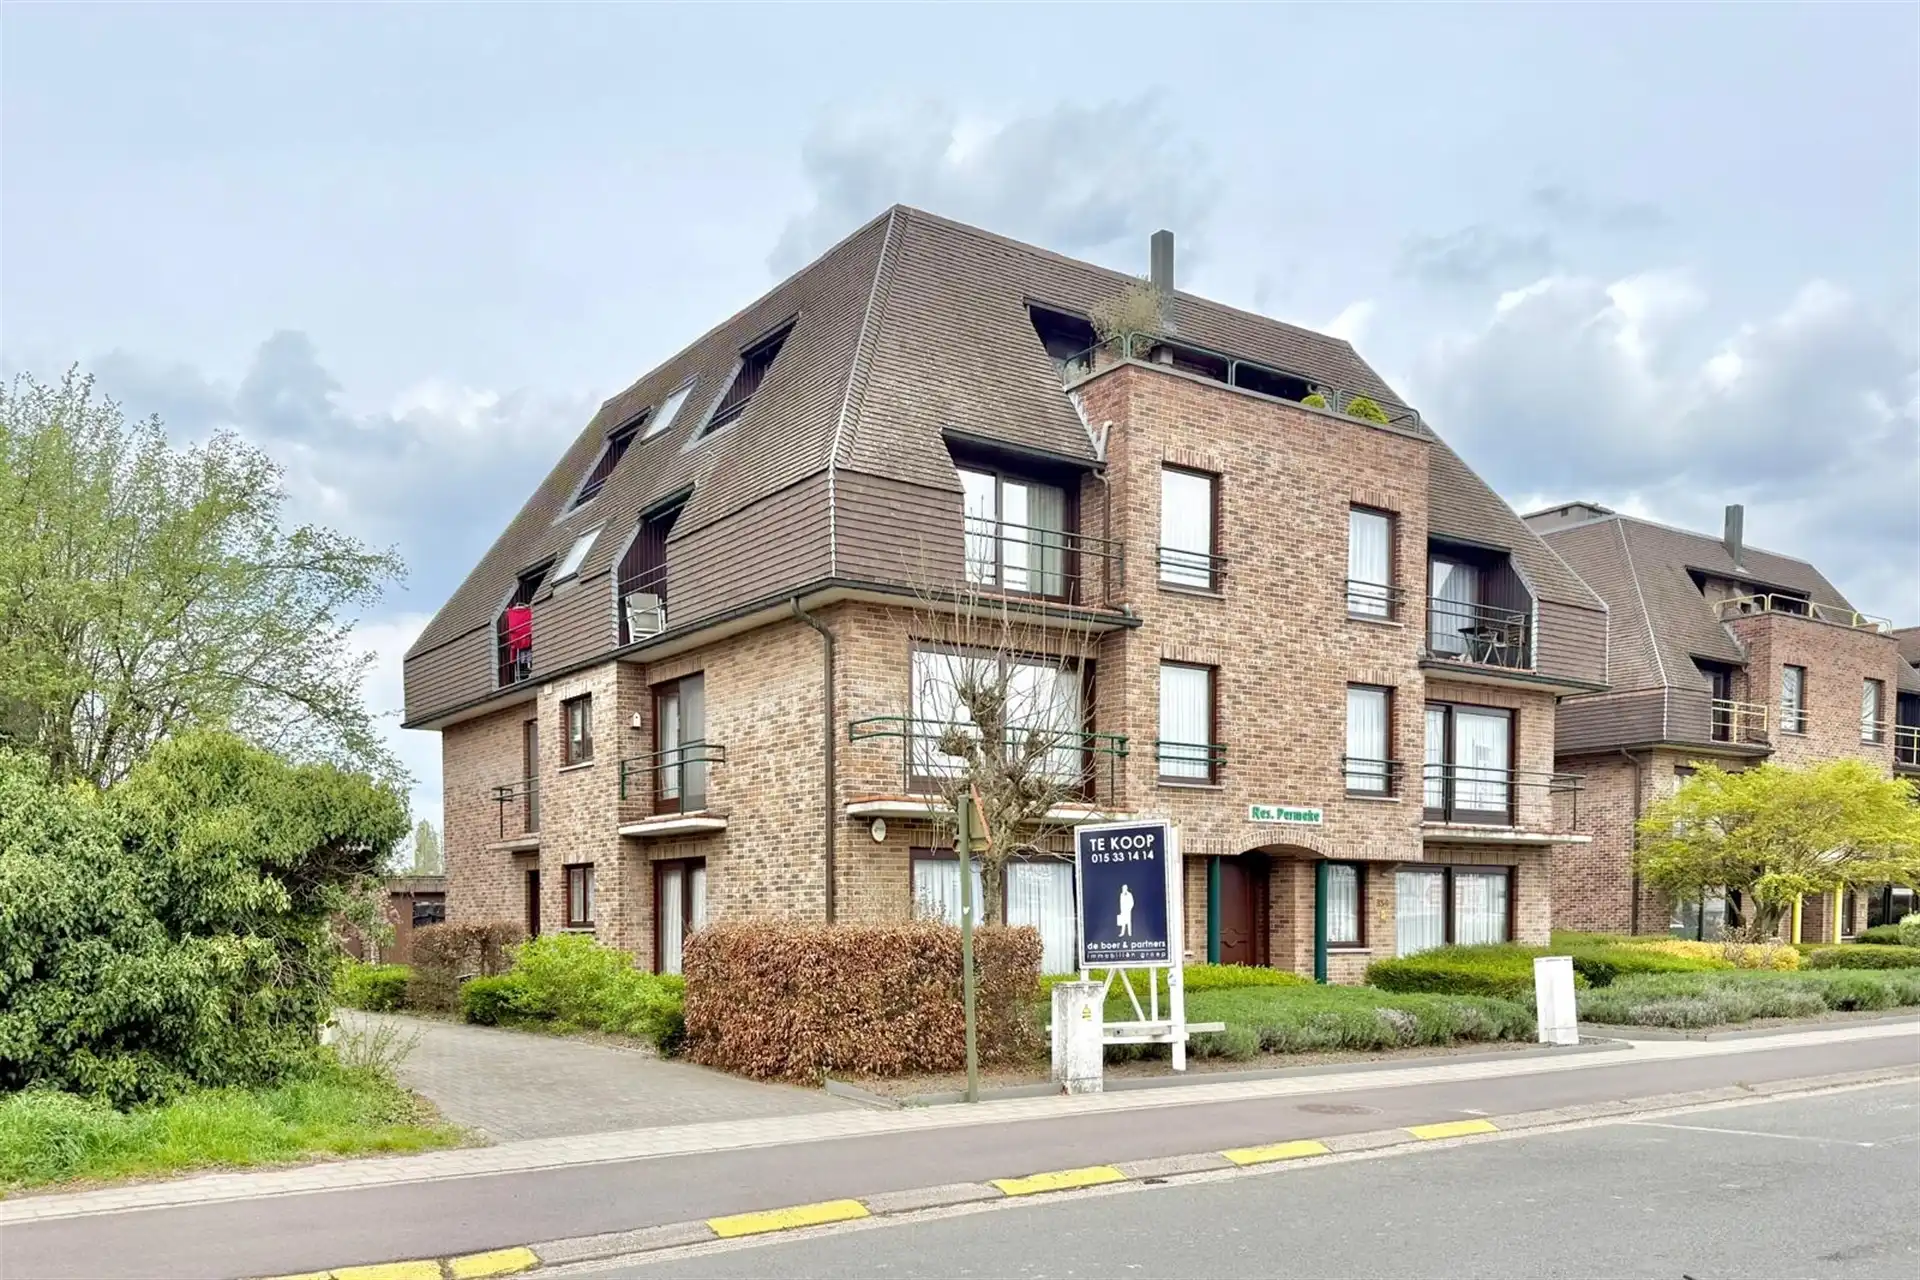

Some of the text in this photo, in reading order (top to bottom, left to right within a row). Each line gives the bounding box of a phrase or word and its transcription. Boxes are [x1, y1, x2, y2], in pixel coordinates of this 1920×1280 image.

[1252, 806, 1274, 820] Res.
[1089, 834, 1155, 851] TE KOOP
[1091, 850, 1154, 863] 015 33 14 14
[1087, 942, 1098, 950] de
[1131, 940, 1166, 951] partners
